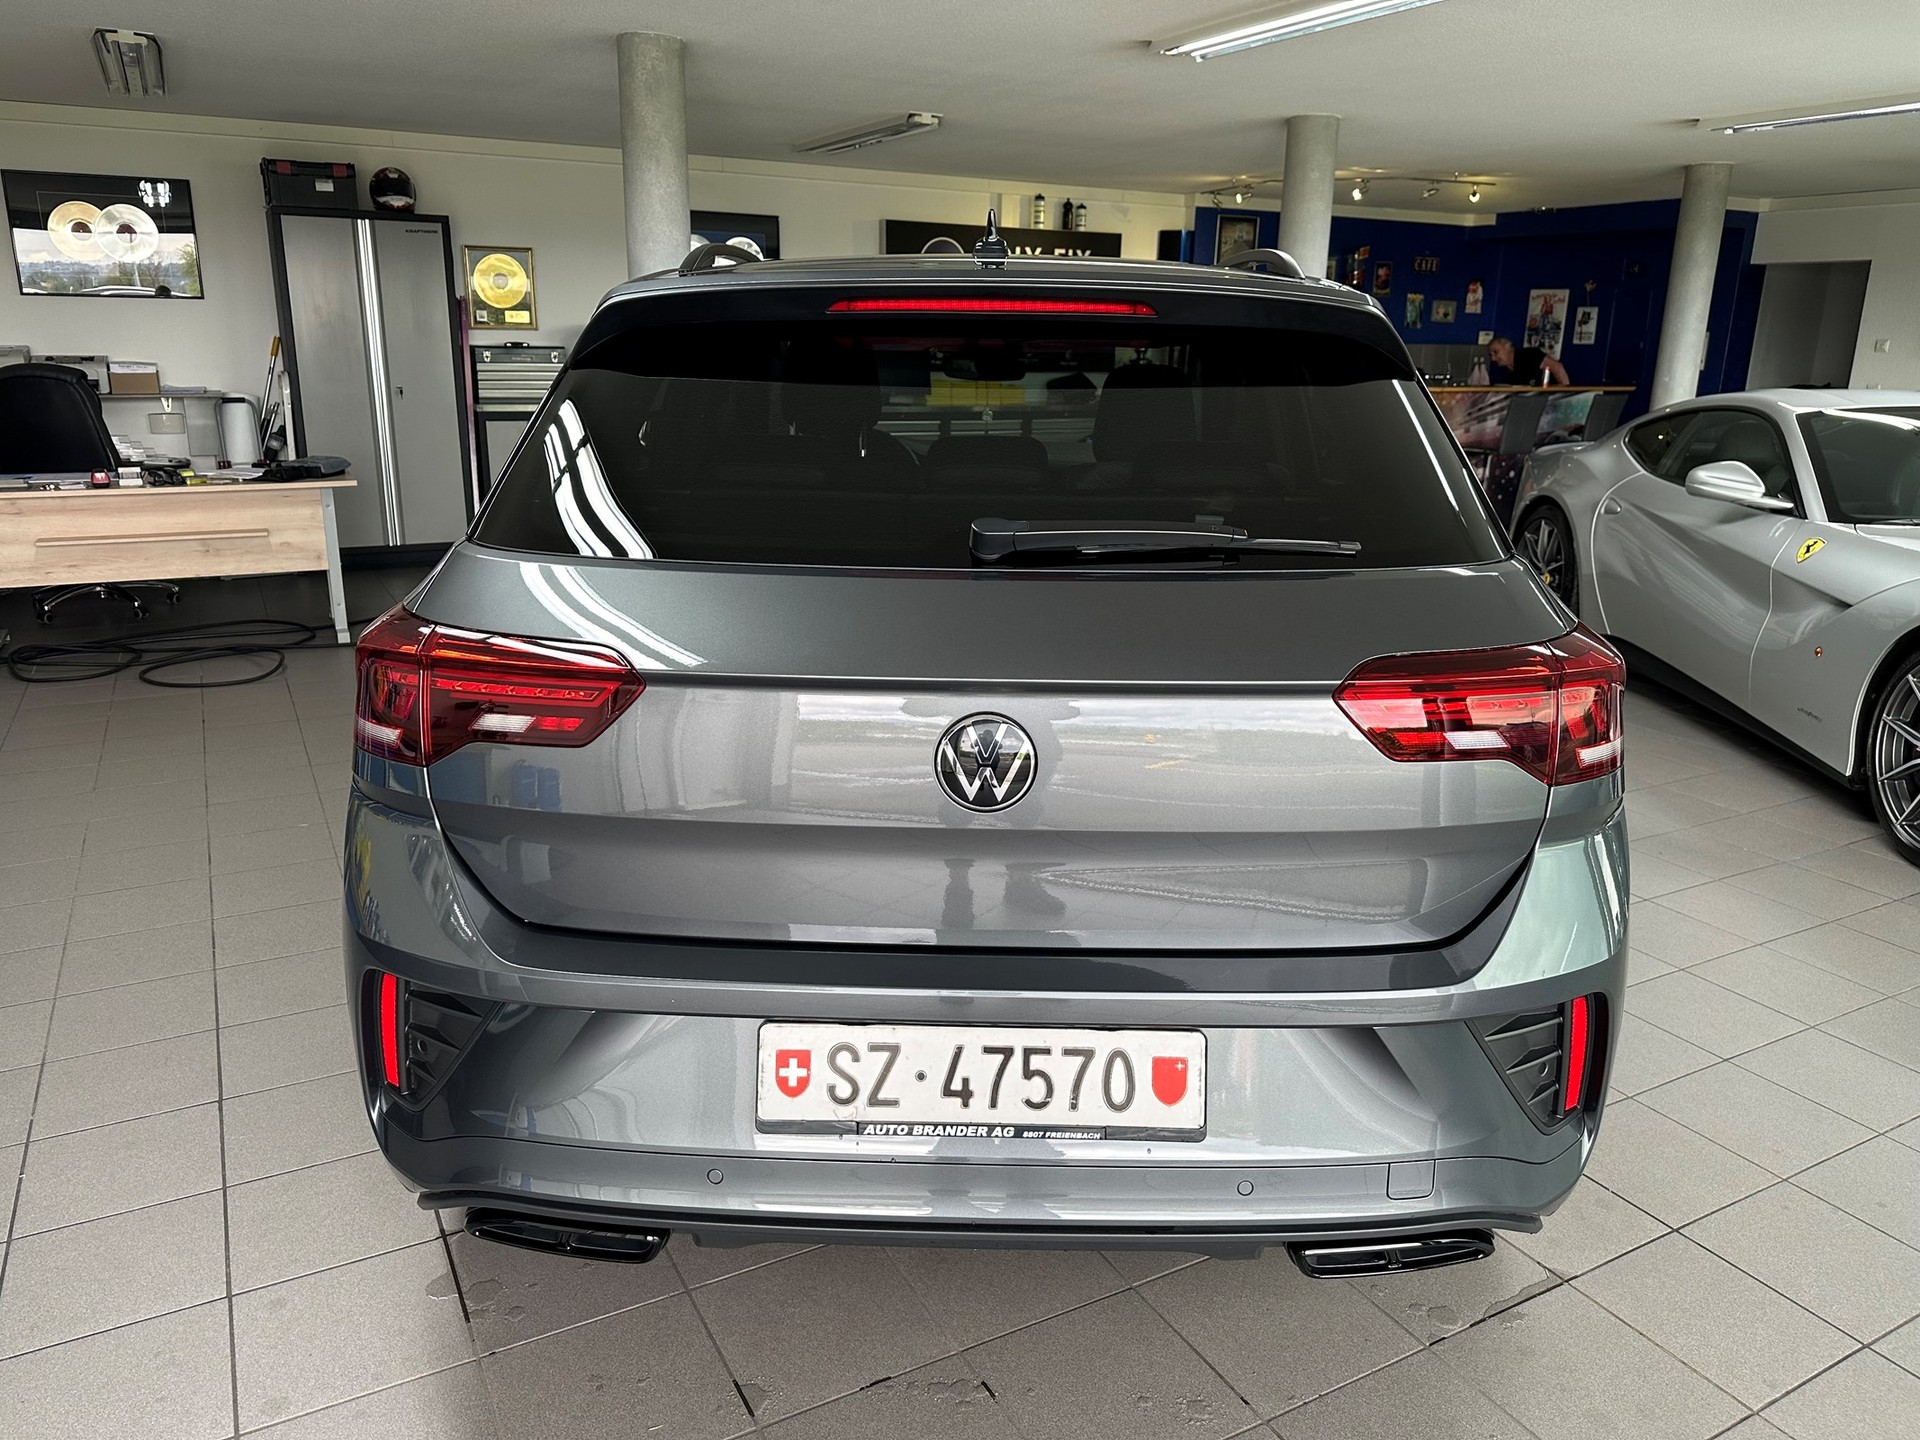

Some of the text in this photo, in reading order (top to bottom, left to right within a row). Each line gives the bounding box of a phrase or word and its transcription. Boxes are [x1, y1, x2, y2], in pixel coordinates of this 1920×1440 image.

[826, 1042, 1136, 1113] SZ 47570
[863, 1123, 909, 1136] AUTO
[912, 1124, 988, 1138] BRANDER
[990, 1126, 1015, 1138] AG
[1045, 1131, 1101, 1140] FREIENBACH
